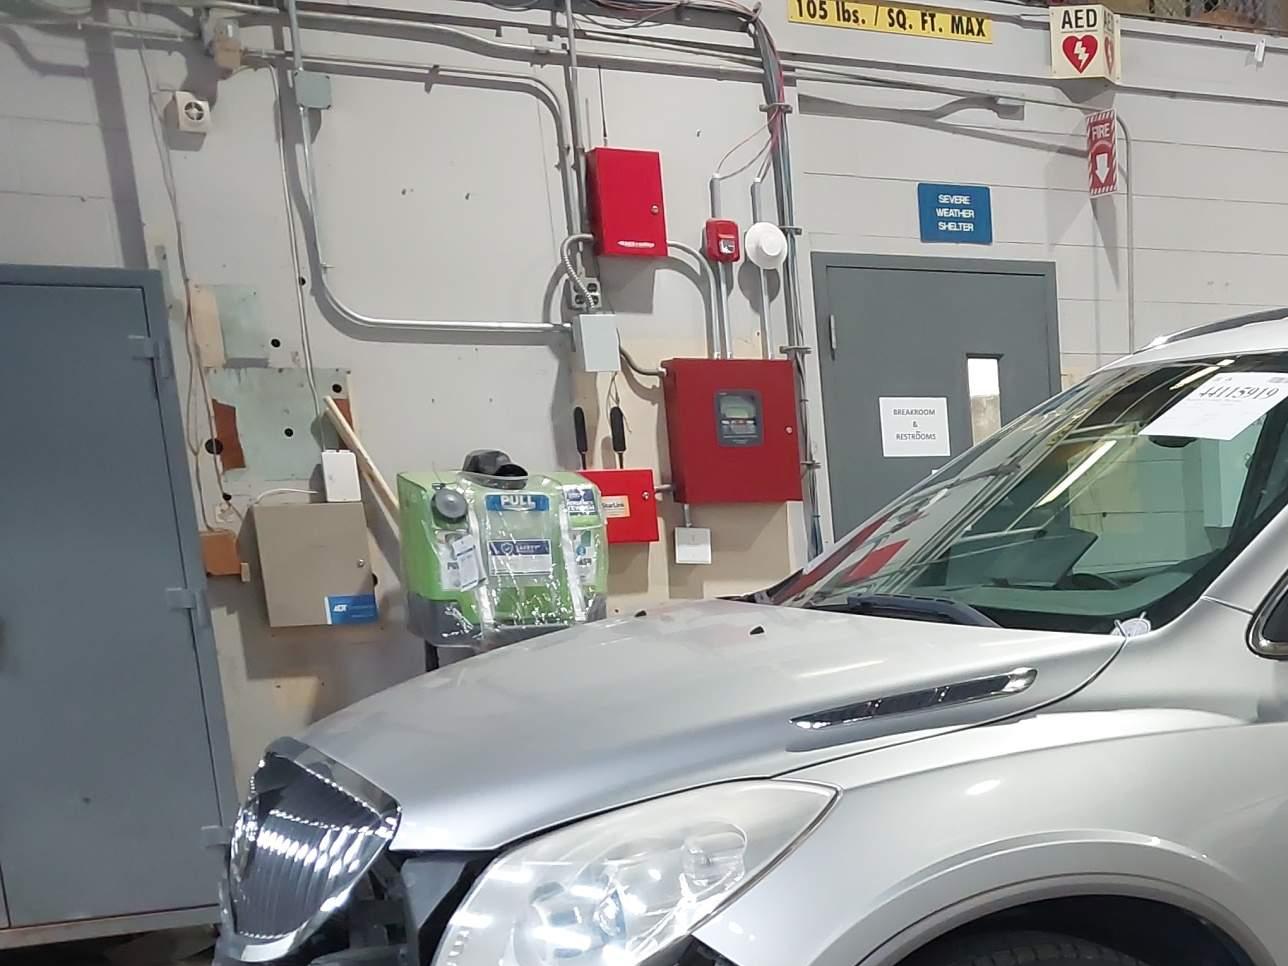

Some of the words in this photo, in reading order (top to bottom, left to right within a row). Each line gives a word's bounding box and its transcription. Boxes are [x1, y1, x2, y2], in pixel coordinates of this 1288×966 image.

[796, 0, 828, 19] 105
[836, 2, 866, 24] lbs.
[888, 8, 913, 30] SQ.
[921, 11, 943, 33] FT.
[951, 15, 986, 37] MAX
[1061, 8, 1097, 29] AED
[1092, 123, 1110, 140] FIRE
[938, 194, 971, 204] SEVERE
[936, 208, 975, 218] WEATHER
[938, 222, 974, 232] SHELTER
[1199, 386, 1280, 400] 44115919
[893, 408, 936, 416] BREAKROOM
[896, 433, 937, 441] RESTROOMS
[501, 495, 536, 507] PULL
